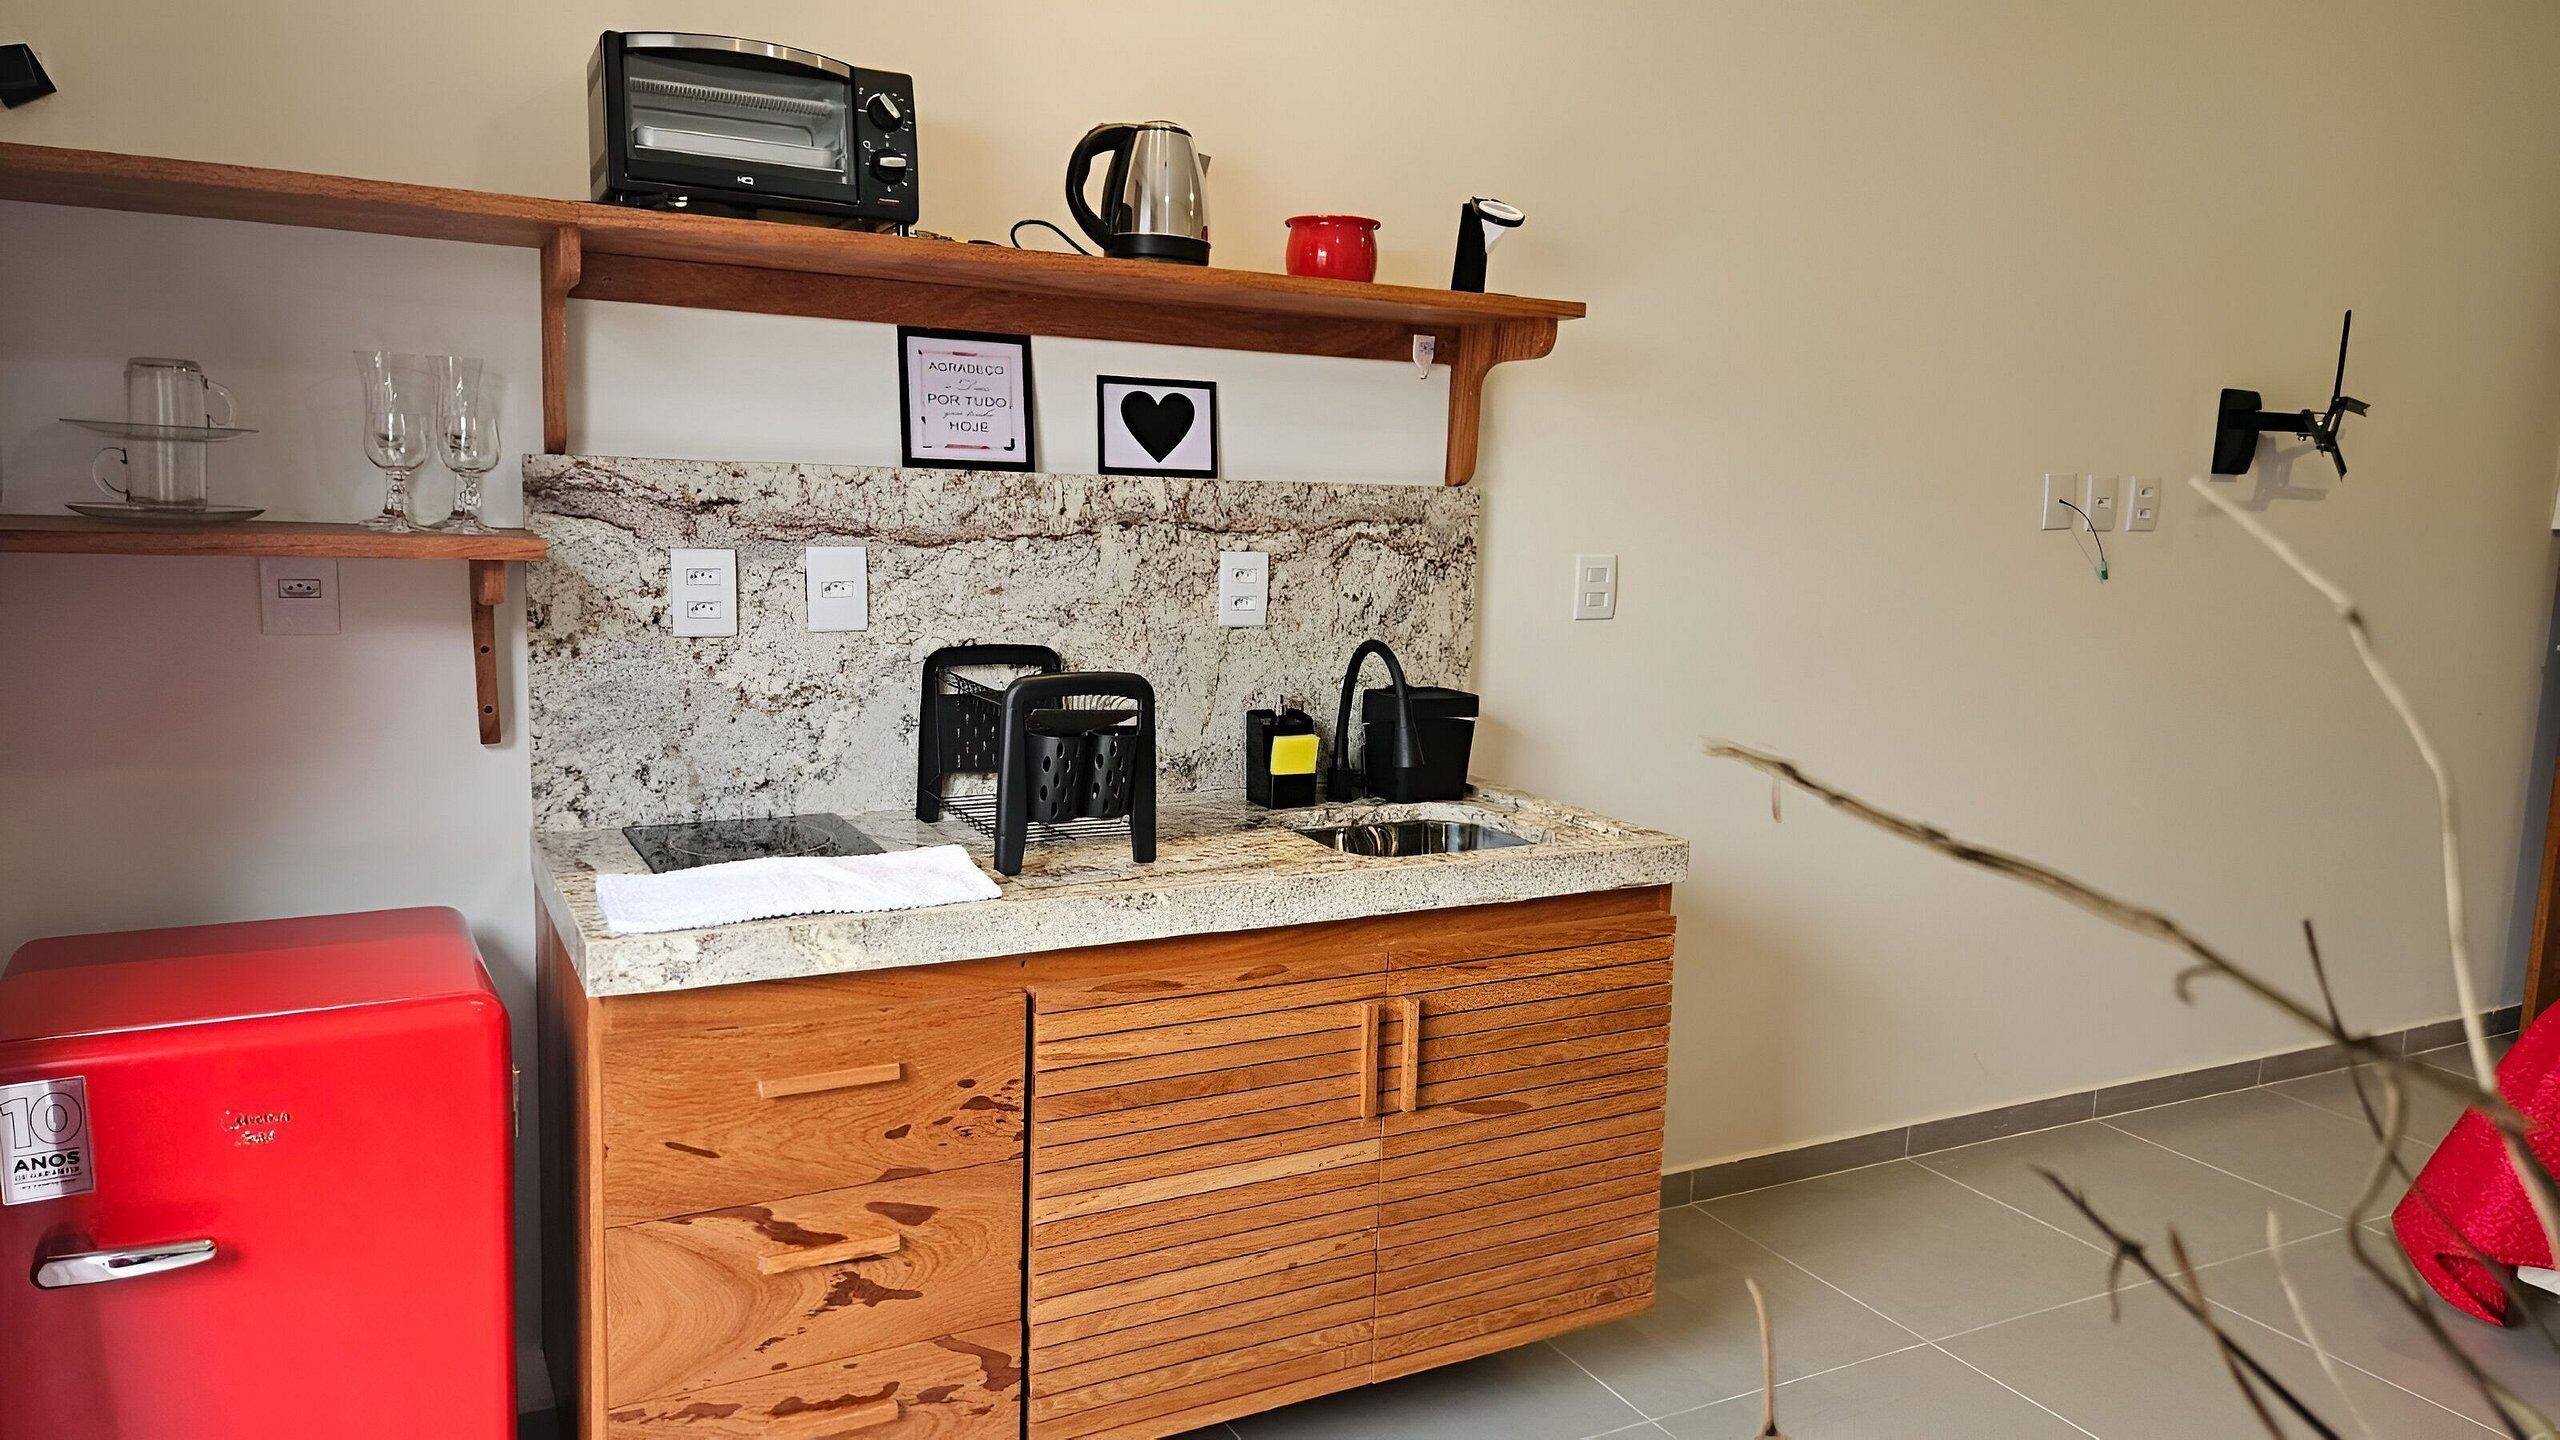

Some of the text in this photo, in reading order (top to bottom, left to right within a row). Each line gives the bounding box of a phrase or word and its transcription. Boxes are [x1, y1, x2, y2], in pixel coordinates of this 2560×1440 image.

[927, 393, 1007, 408] POR TUDO
[949, 421, 989, 433] HOJE
[0, 1092, 82, 1149] 10
[14, 1151, 80, 1174] ANOS
